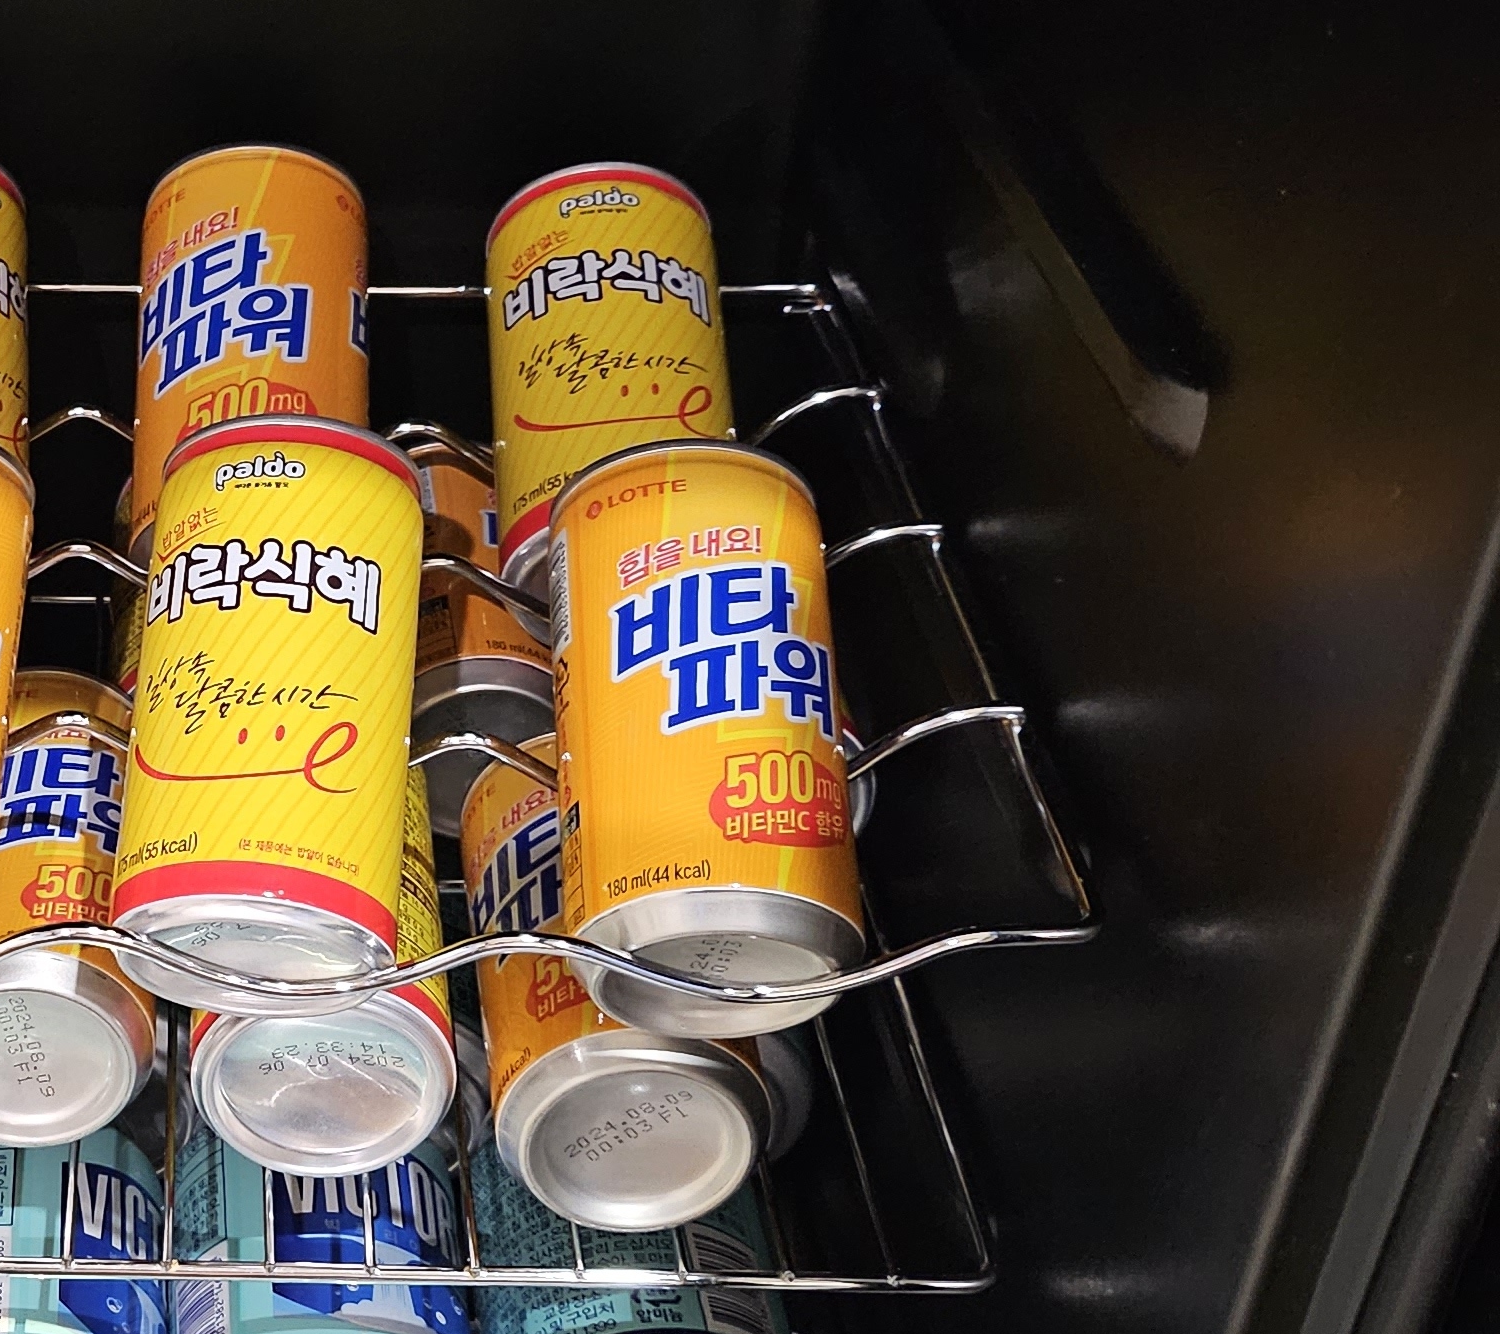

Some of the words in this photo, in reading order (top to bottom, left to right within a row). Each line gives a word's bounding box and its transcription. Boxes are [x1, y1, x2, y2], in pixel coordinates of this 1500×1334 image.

[182, 206, 240, 249] 내요!
[559, 186, 641, 219] paldo
[511, 228, 570, 272] 밥알없는
[141, 231, 268, 364] 비타
[503, 249, 712, 331] 비락식혜
[156, 286, 310, 396] 파워
[553, 347, 640, 396] 달콤한
[643, 354, 710, 376] 시간
[188, 378, 306, 429] 500mg
[215, 451, 306, 492] paldo
[607, 478, 688, 509] LOTTE
[160, 506, 219, 550] 밥알없는
[618, 537, 686, 589] 힘을
[692, 526, 763, 557] 내요!
[147, 538, 382, 635] 비락식혜
[614, 565, 795, 677] 비타
[174, 676, 267, 735] 달콤한
[272, 684, 359, 710] 시간
[667, 639, 833, 738] 파워
[724, 750, 843, 811] 500mg
[160, 830, 199, 855] kcal)
[726, 808, 811, 839] 비타민C
[814, 810, 846, 839] 함유
[674, 859, 712, 880] kcal)
[563, 1089, 694, 1159] 2024.08.09
[585, 1119, 654, 1162] 00:03
